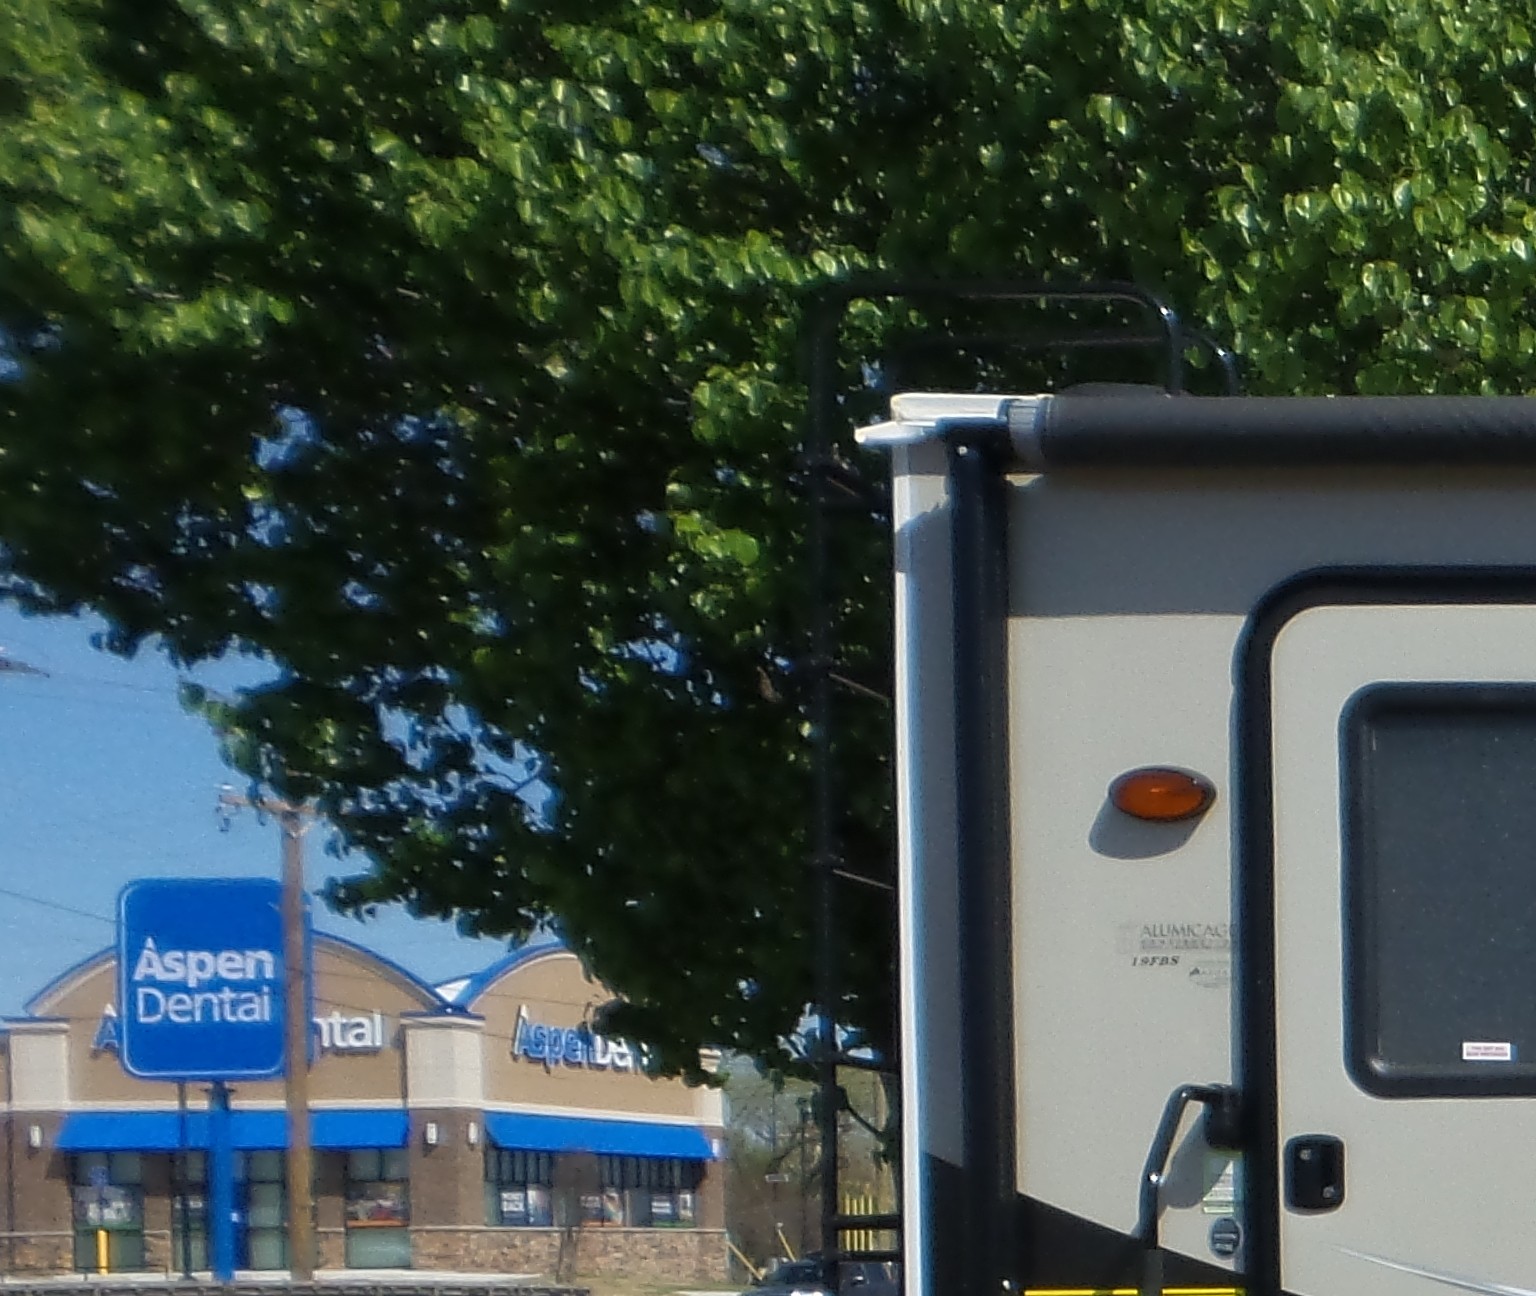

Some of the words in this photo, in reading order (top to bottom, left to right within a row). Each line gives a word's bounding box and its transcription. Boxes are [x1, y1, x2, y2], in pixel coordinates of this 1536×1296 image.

[133, 937, 275, 988] Aspen
[136, 986, 272, 1024] Dental
[311, 1010, 382, 1050] ntal
